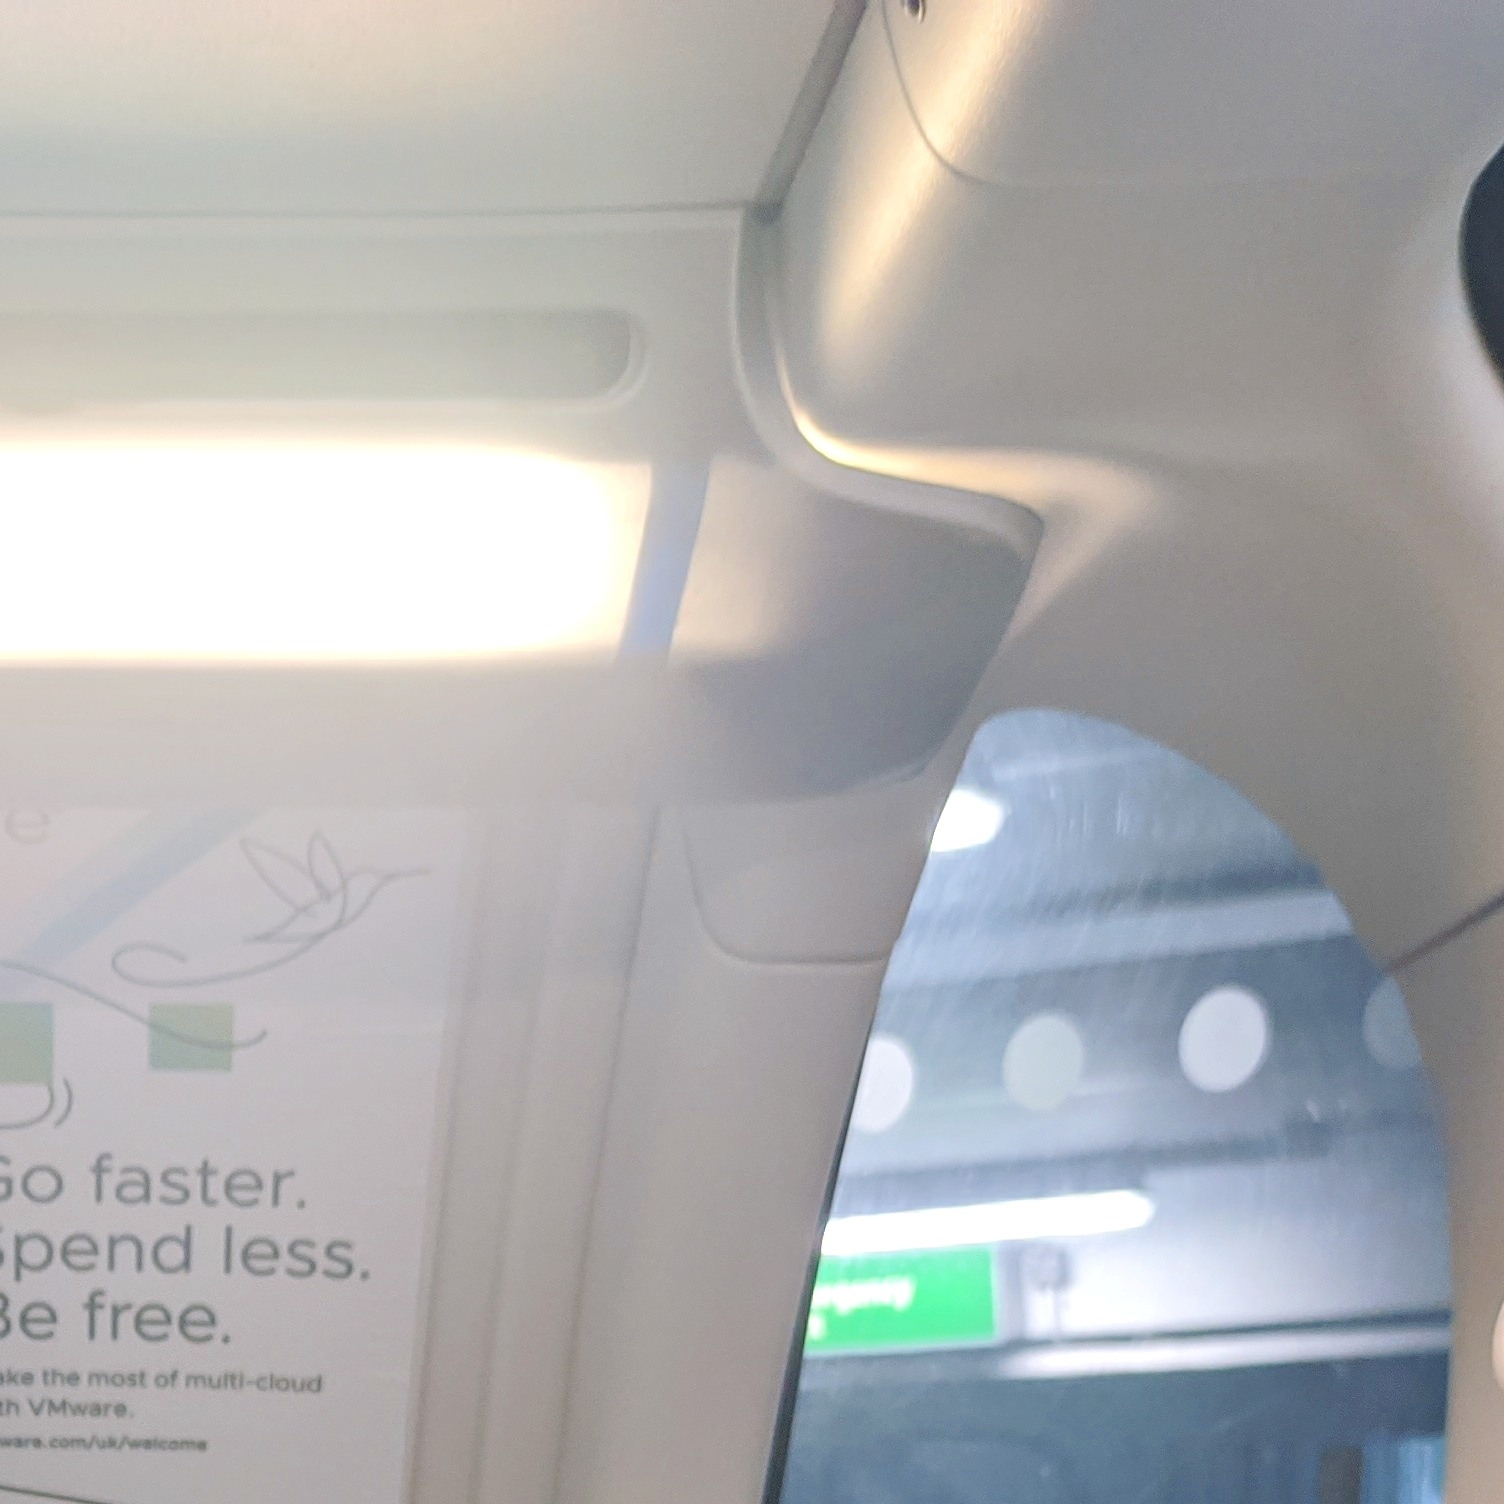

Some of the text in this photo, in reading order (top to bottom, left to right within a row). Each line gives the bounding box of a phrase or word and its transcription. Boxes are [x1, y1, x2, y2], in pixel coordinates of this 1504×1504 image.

[90, 1152, 306, 1209] faster.
[223, 1224, 370, 1281] less.
[83, 1288, 231, 1345] free.
[42, 1368, 80, 1387] the
[88, 1370, 146, 1388] most
[154, 1369, 179, 1388] of
[185, 1372, 323, 1393] multi-cloud
[28, 1401, 134, 1418] VMware.
